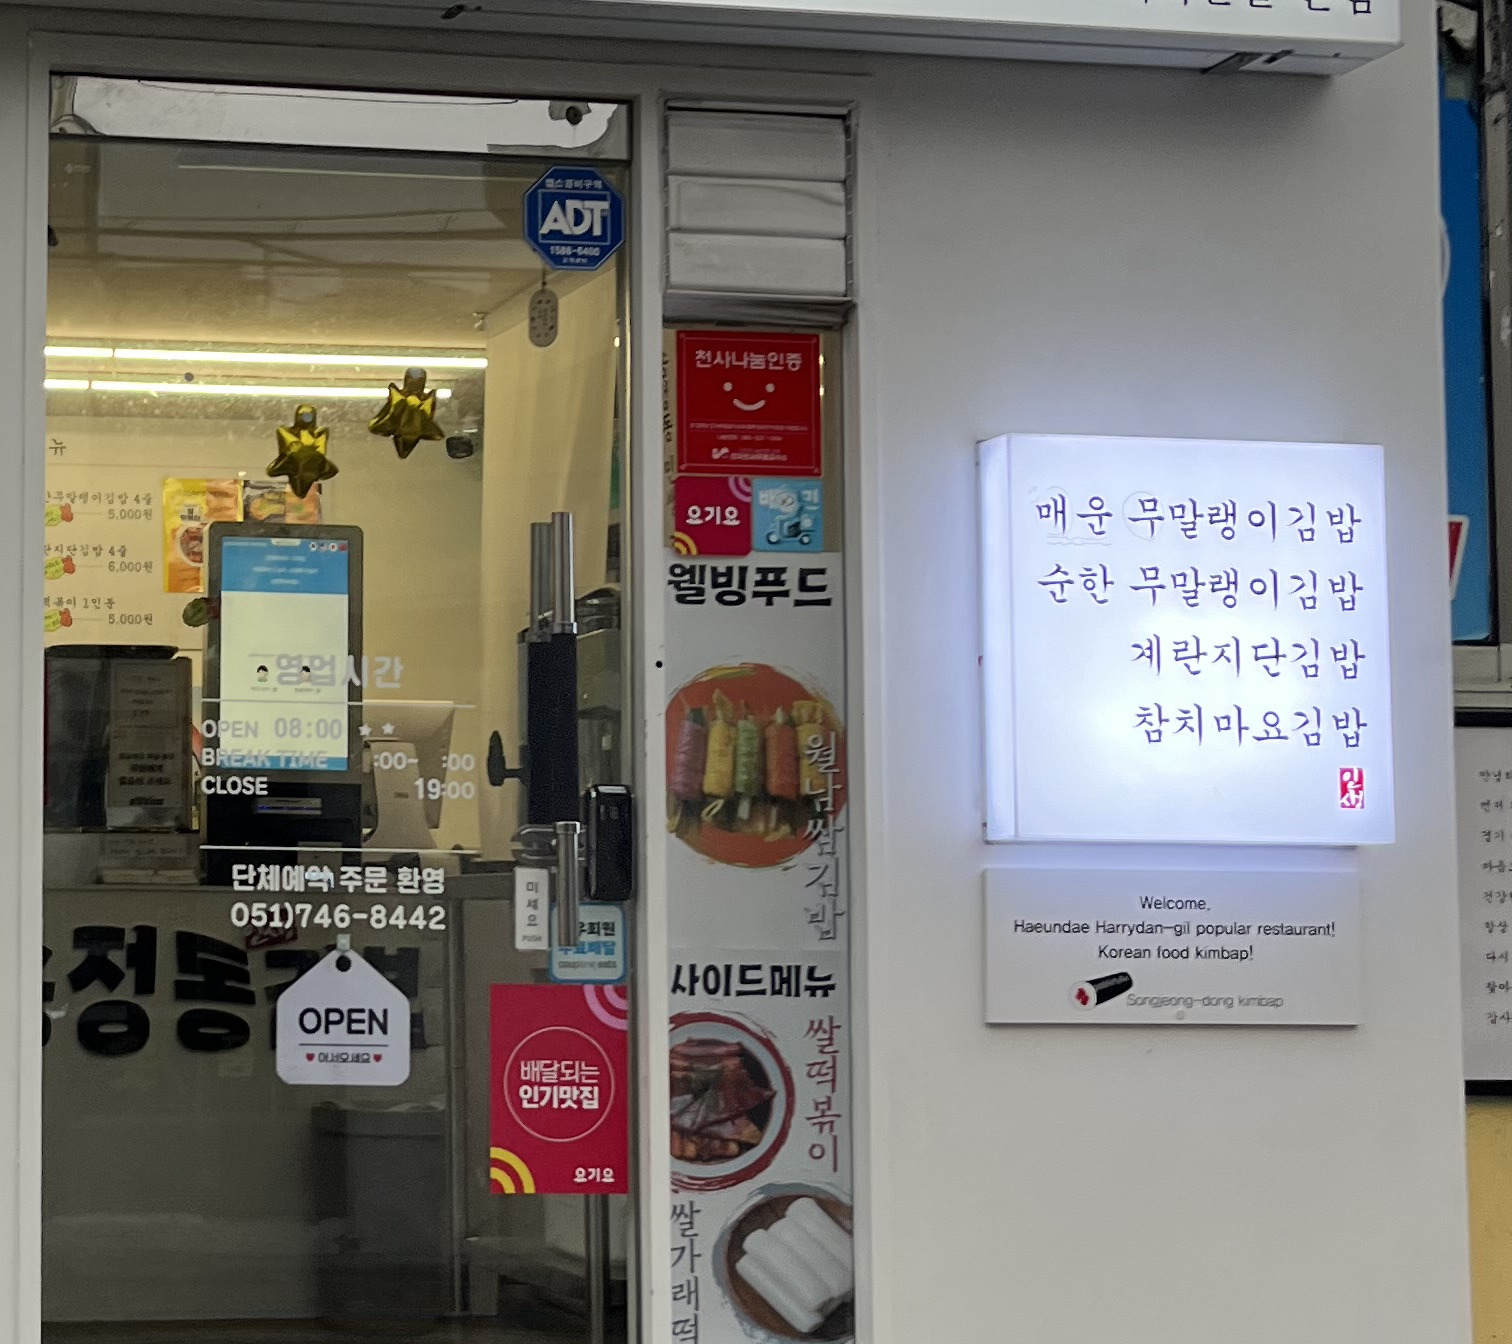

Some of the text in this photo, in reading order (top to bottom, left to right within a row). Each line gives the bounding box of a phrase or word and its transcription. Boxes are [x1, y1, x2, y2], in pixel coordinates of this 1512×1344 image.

[539, 199, 611, 237] ADT
[695, 349, 803, 371] 천사나눔인증
[685, 505, 741, 526] 요기요
[1035, 494, 1362, 545] 매운 무말랭이김밥
[667, 562, 833, 608] 웰빙푸드
[1036, 564, 1364, 613] 순한 무말랭이김밥
[276, 654, 404, 689] 영업시간
[1132, 635, 1366, 681] 계란지단김밥
[202, 717, 343, 740] OPEN 08:00
[1133, 702, 1369, 749] 참치마요김밥
[202, 748, 271, 768] BREAK
[276, 750, 329, 769] TIME
[201, 776, 475, 800] CLOSE 19:00
[231, 863, 446, 895] 단체예약 주문 환영
[230, 902, 447, 931] 051)746-8442
[1013, 919, 1336, 939] Haeundae Harrydan-gil popular restaurant!
[1098, 944, 1254, 962] Korean food kimbap!
[670, 963, 837, 998] 사이드메뉴
[298, 1007, 389, 1036] OPEN
[519, 1059, 600, 1085] 배달되는
[518, 1084, 600, 1111] 인기맛집
[804, 1015, 842, 1173] 쌀떡볶이
[573, 1167, 615, 1184] 요기요
